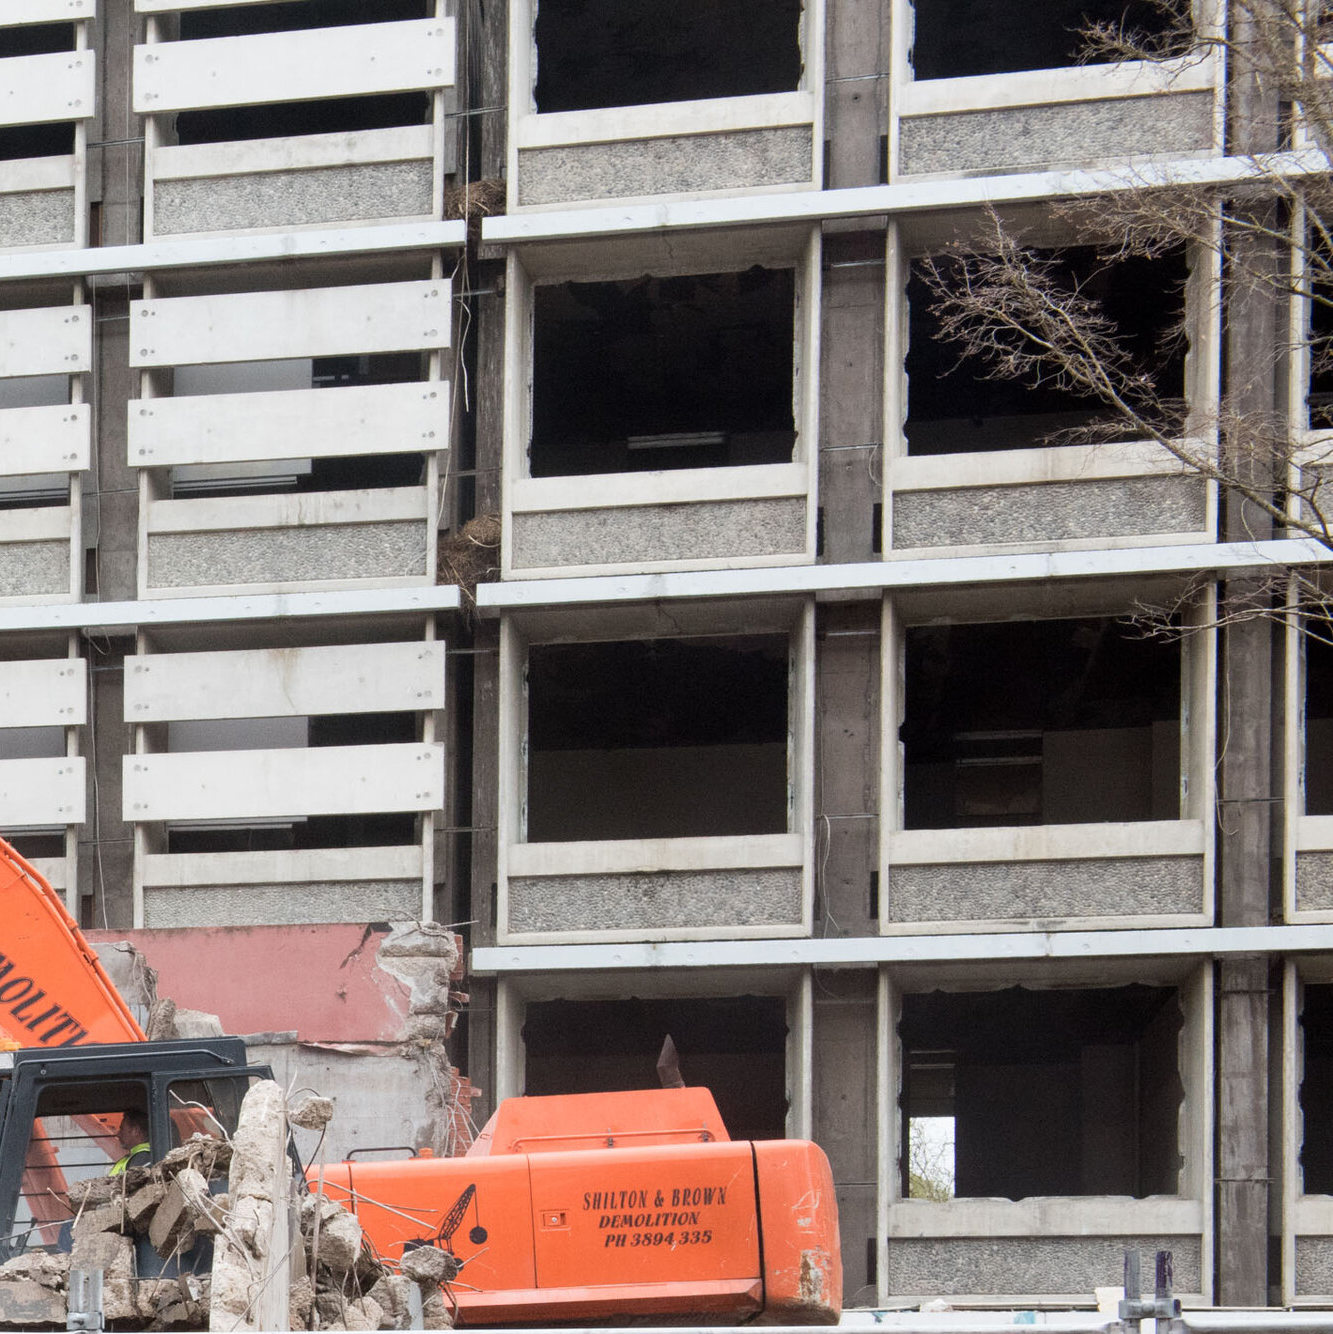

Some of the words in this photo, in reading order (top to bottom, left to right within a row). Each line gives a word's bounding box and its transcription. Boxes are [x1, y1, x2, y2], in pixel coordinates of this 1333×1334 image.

[583, 1191, 647, 1210] SHILTON
[654, 1190, 664, 1208] &
[672, 1187, 726, 1206] BROWN
[599, 1212, 700, 1228] DEMOLITION
[605, 1234, 626, 1247] PH
[679, 1230, 712, 1244] 335
